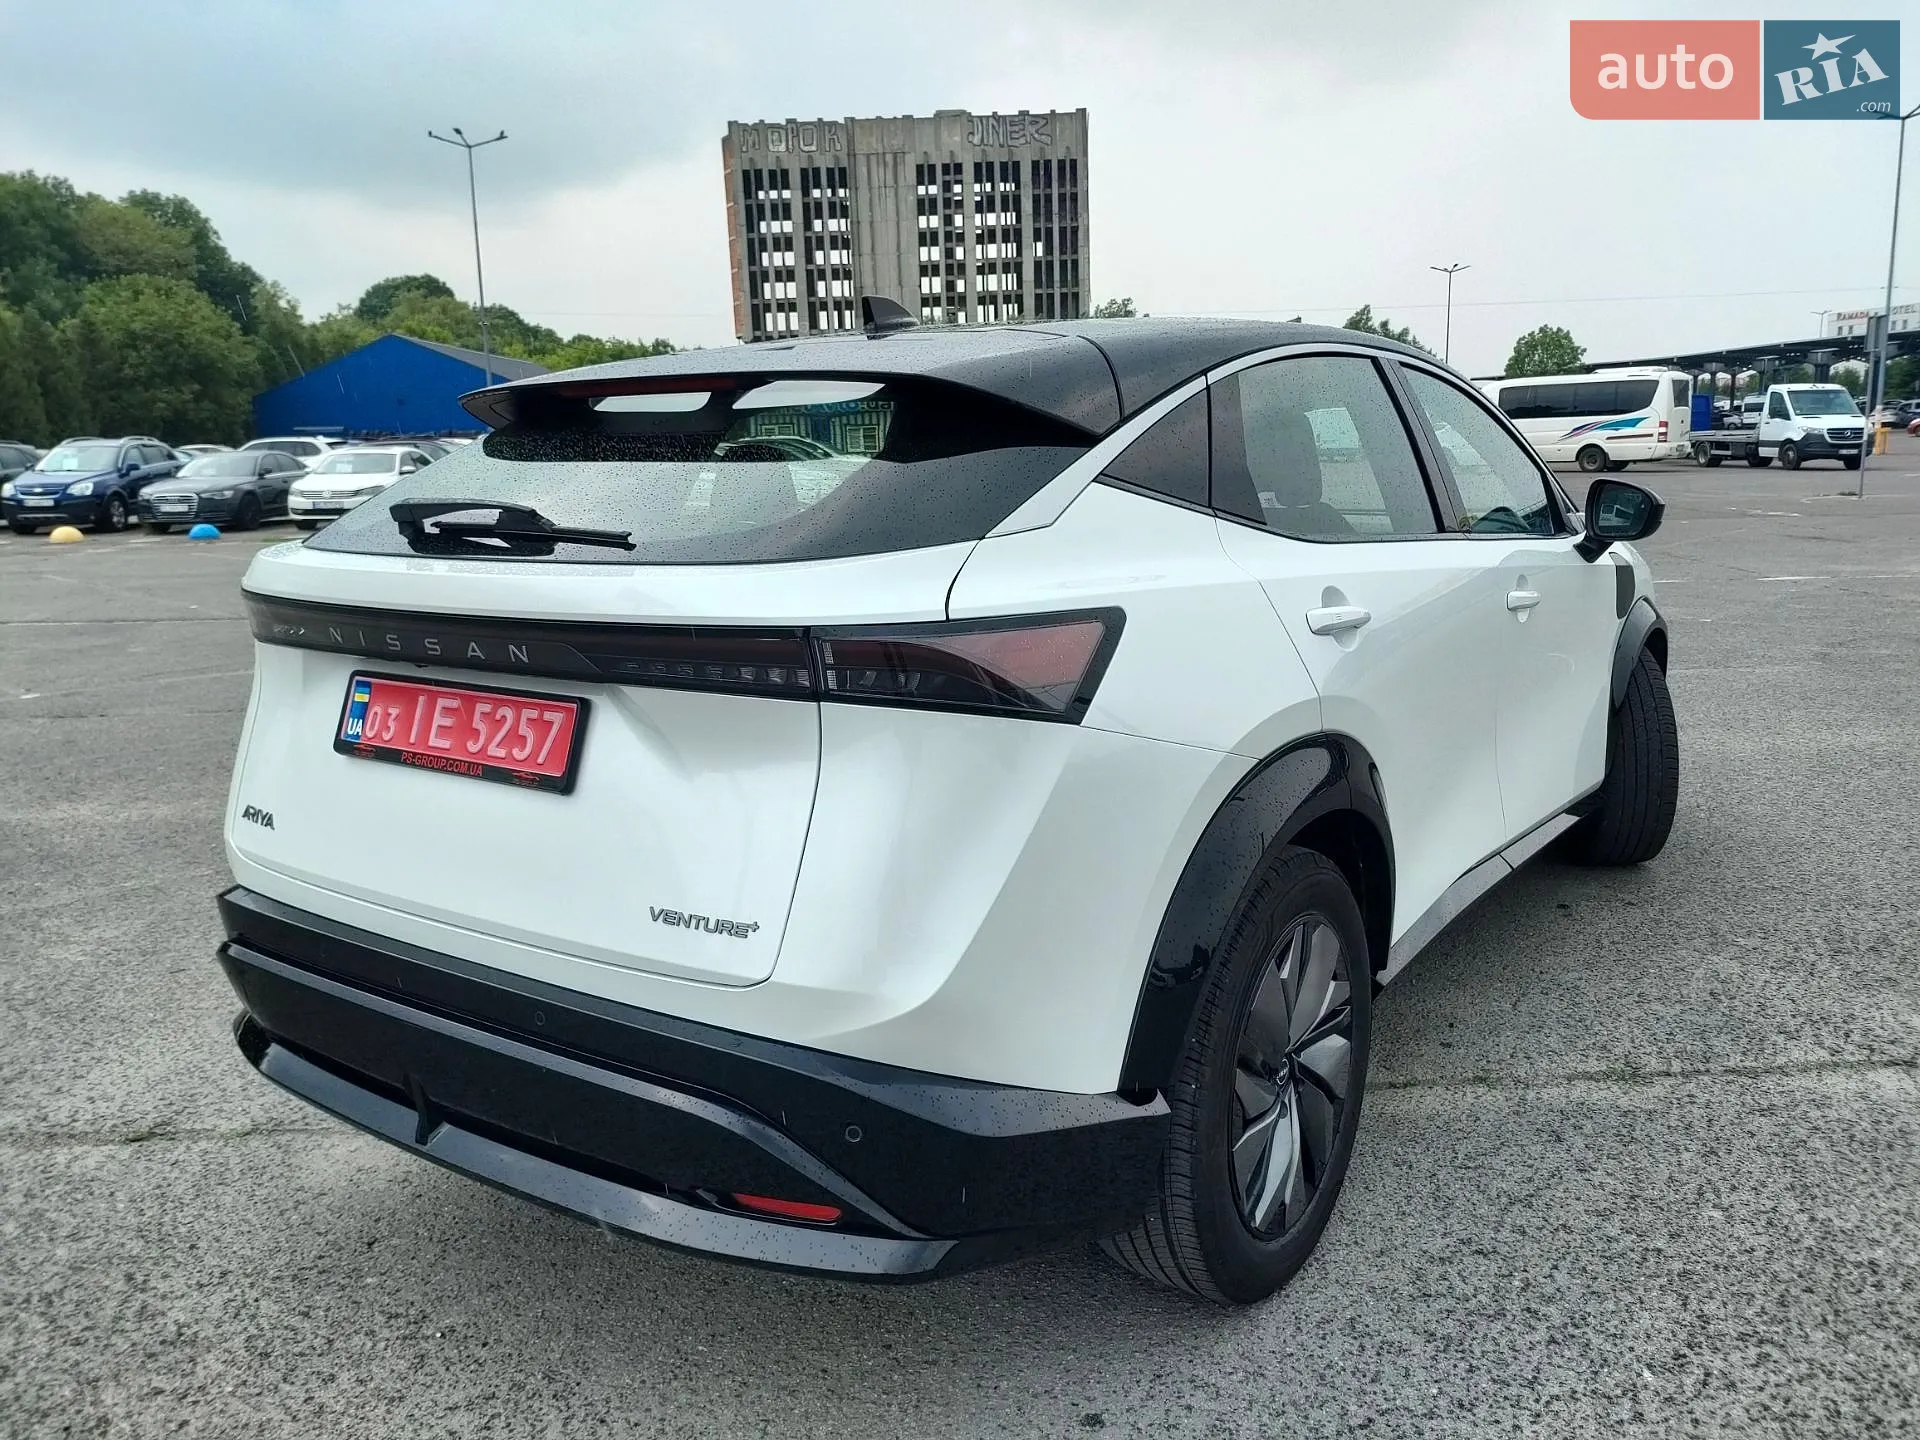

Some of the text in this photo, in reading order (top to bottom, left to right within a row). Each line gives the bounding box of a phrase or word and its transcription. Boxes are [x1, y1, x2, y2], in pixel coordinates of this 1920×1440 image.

[328, 625, 529, 664] NISSAN
[346, 717, 362, 736] UA
[365, 695, 564, 766] 03 IE 5257
[401, 751, 484, 777] PS-GROUP.COM.UA
[241, 804, 275, 831] ARIYA
